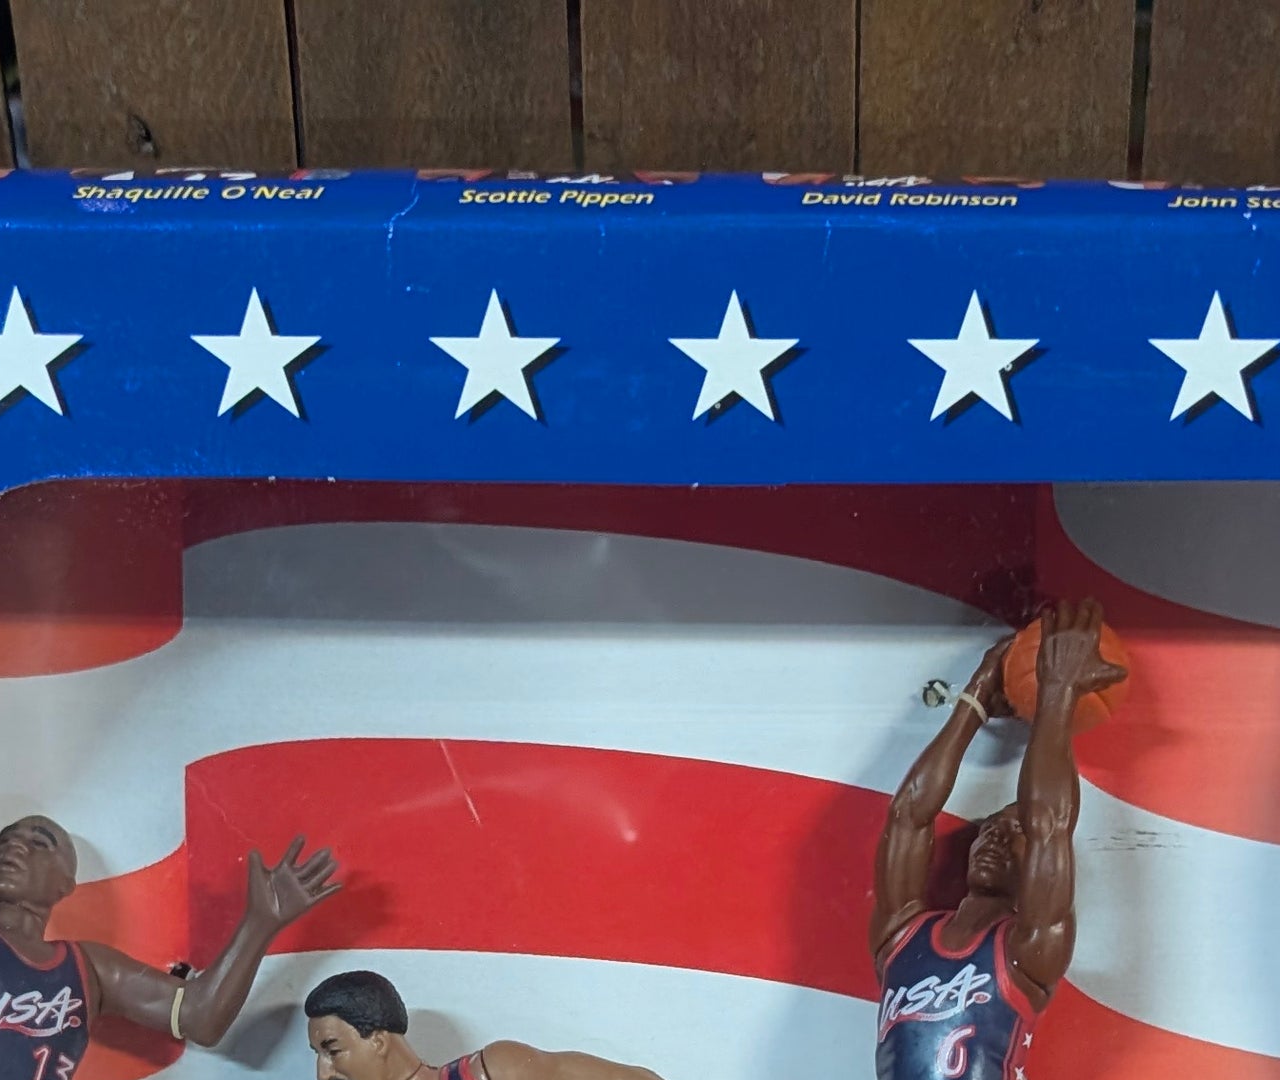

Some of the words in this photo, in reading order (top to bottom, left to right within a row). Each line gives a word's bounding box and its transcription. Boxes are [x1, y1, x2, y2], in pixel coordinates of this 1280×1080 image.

[73, 185, 210, 203] Shaquille
[221, 185, 325, 200] O'Neal
[459, 189, 551, 204] Scottie
[559, 189, 654, 208] Pippen
[802, 192, 881, 206] David
[890, 192, 1018, 207] Robinson
[1168, 195, 1237, 208] John
[879, 964, 992, 1030] USA
[935, 1025, 975, 1080] 6
